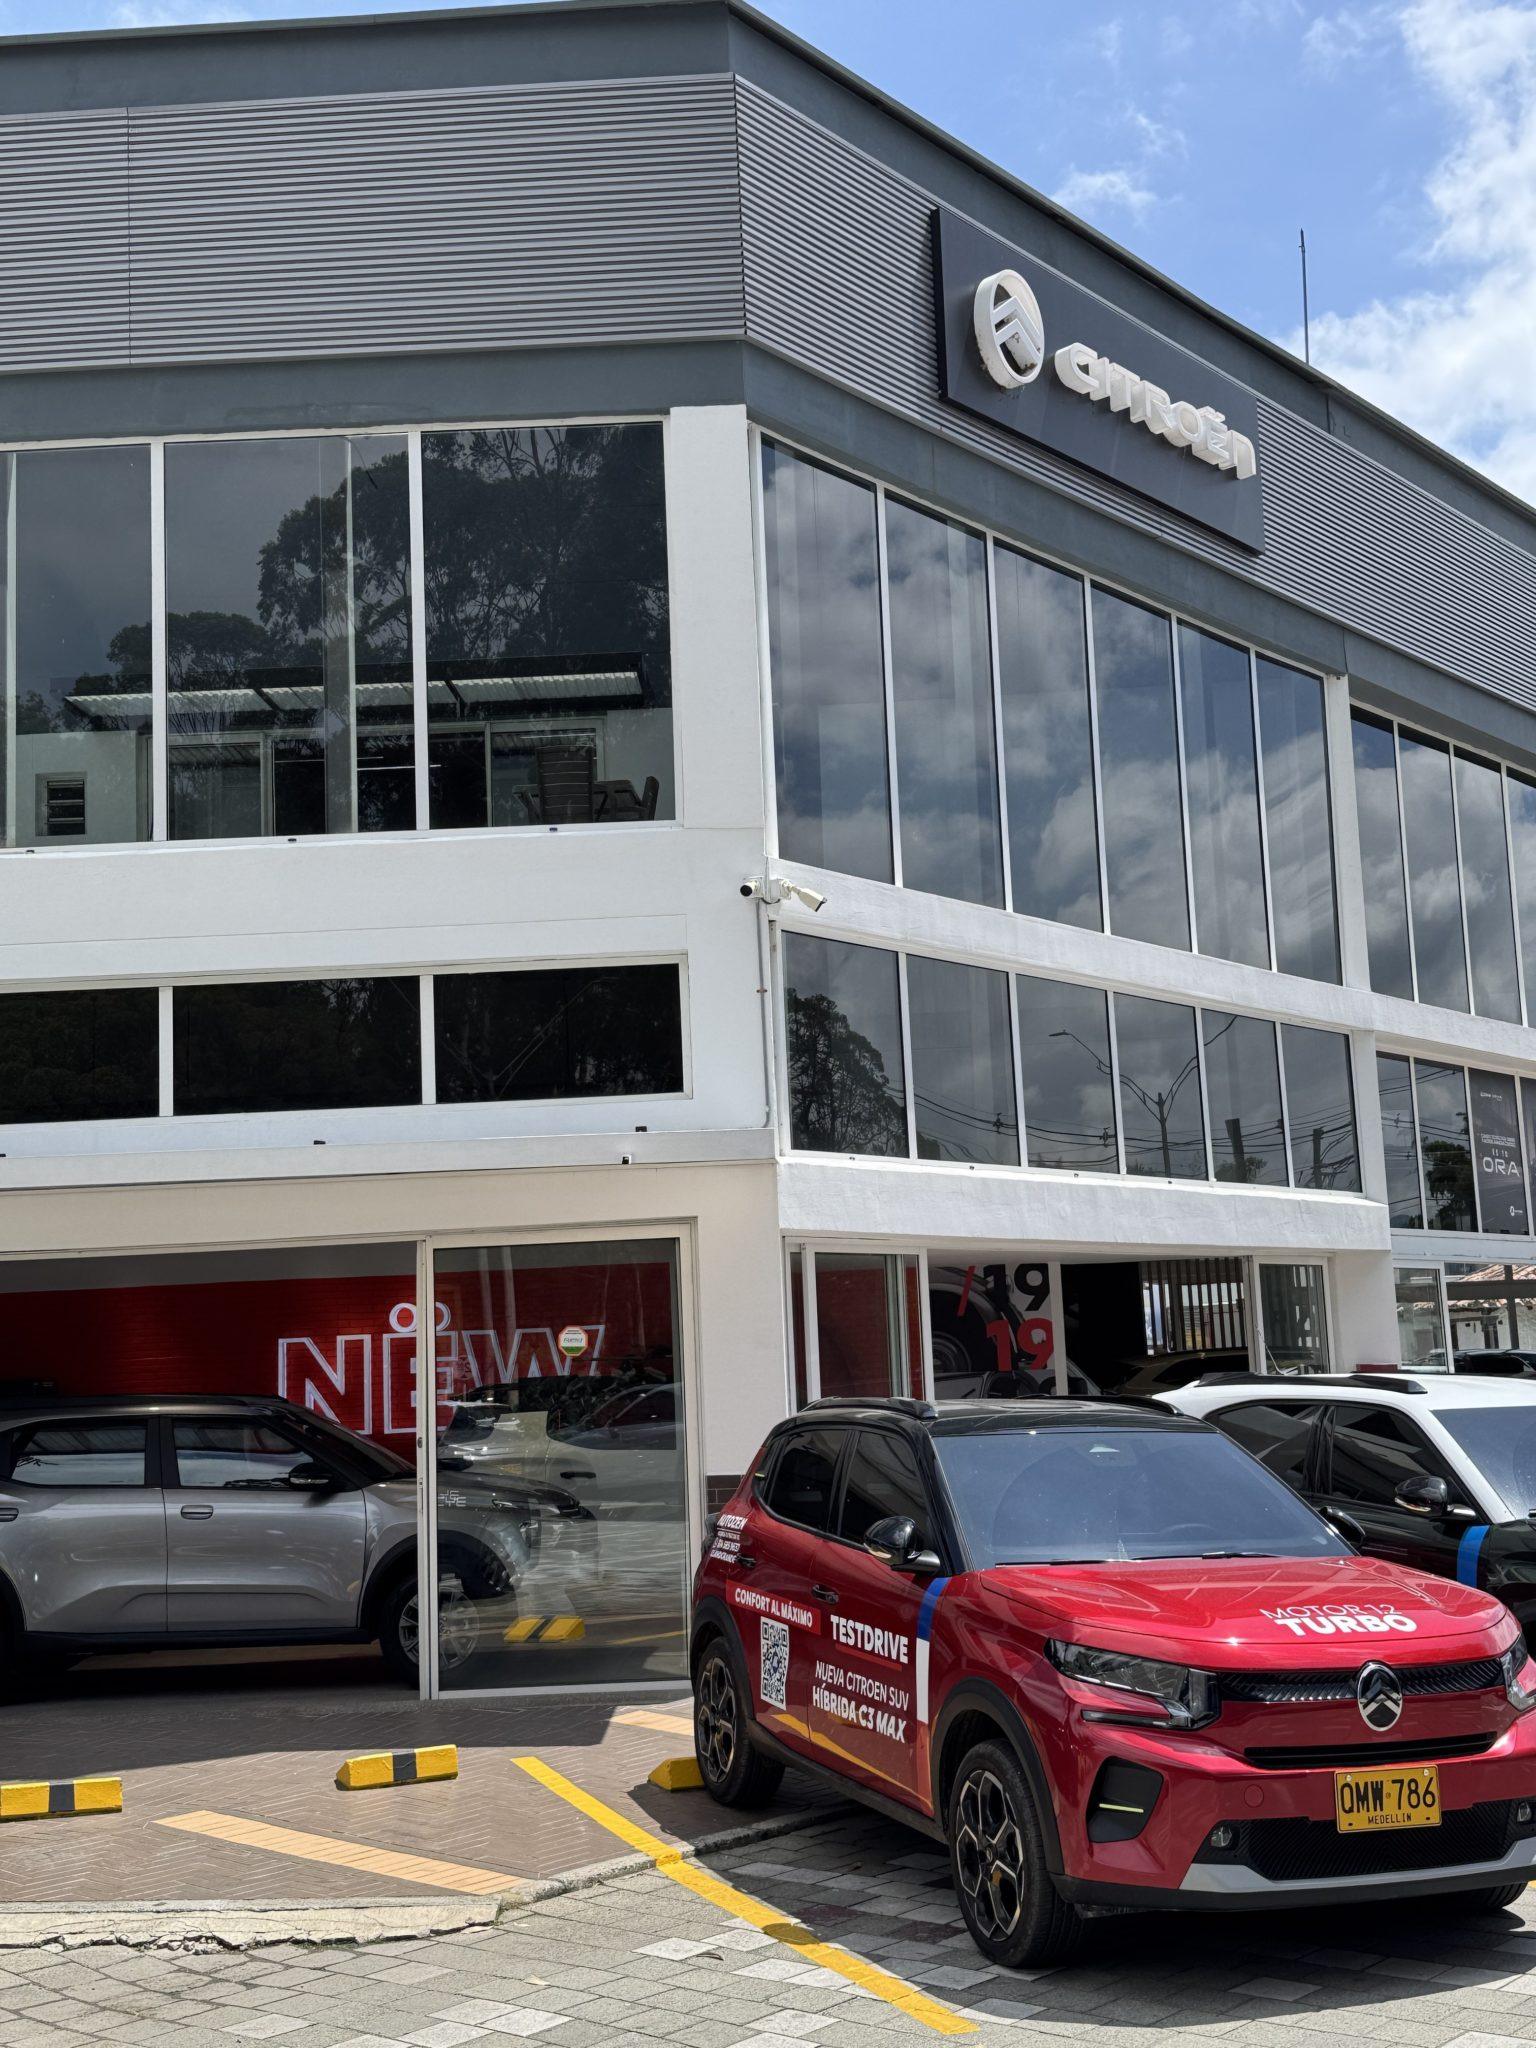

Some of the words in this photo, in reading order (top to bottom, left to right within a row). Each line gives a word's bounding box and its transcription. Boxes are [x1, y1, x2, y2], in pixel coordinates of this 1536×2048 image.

[1482, 1156, 1520, 1178] ORA
[734, 1587, 770, 1612] CONFORT
[770, 1601, 781, 1616] AL
[781, 1600, 813, 1628] MÁXIMO
[1259, 1604, 1367, 1621] MOTOR
[1367, 1604, 1403, 1616] 1.2
[1275, 1614, 1418, 1637] TURBO
[830, 1614, 909, 1664] TESTDRIVE
[815, 1660, 845, 1684] NUEVA
[846, 1671, 888, 1702] CITROEN
[889, 1686, 909, 1712] SUV
[812, 1683, 856, 1723] HÍBRIDA
[858, 1706, 875, 1731] C3
[876, 1714, 906, 1743] MAX
[1340, 1780, 1383, 1814] QMW
[1391, 1776, 1437, 1811] 786
[1368, 1811, 1412, 1825] MEDELLIN
